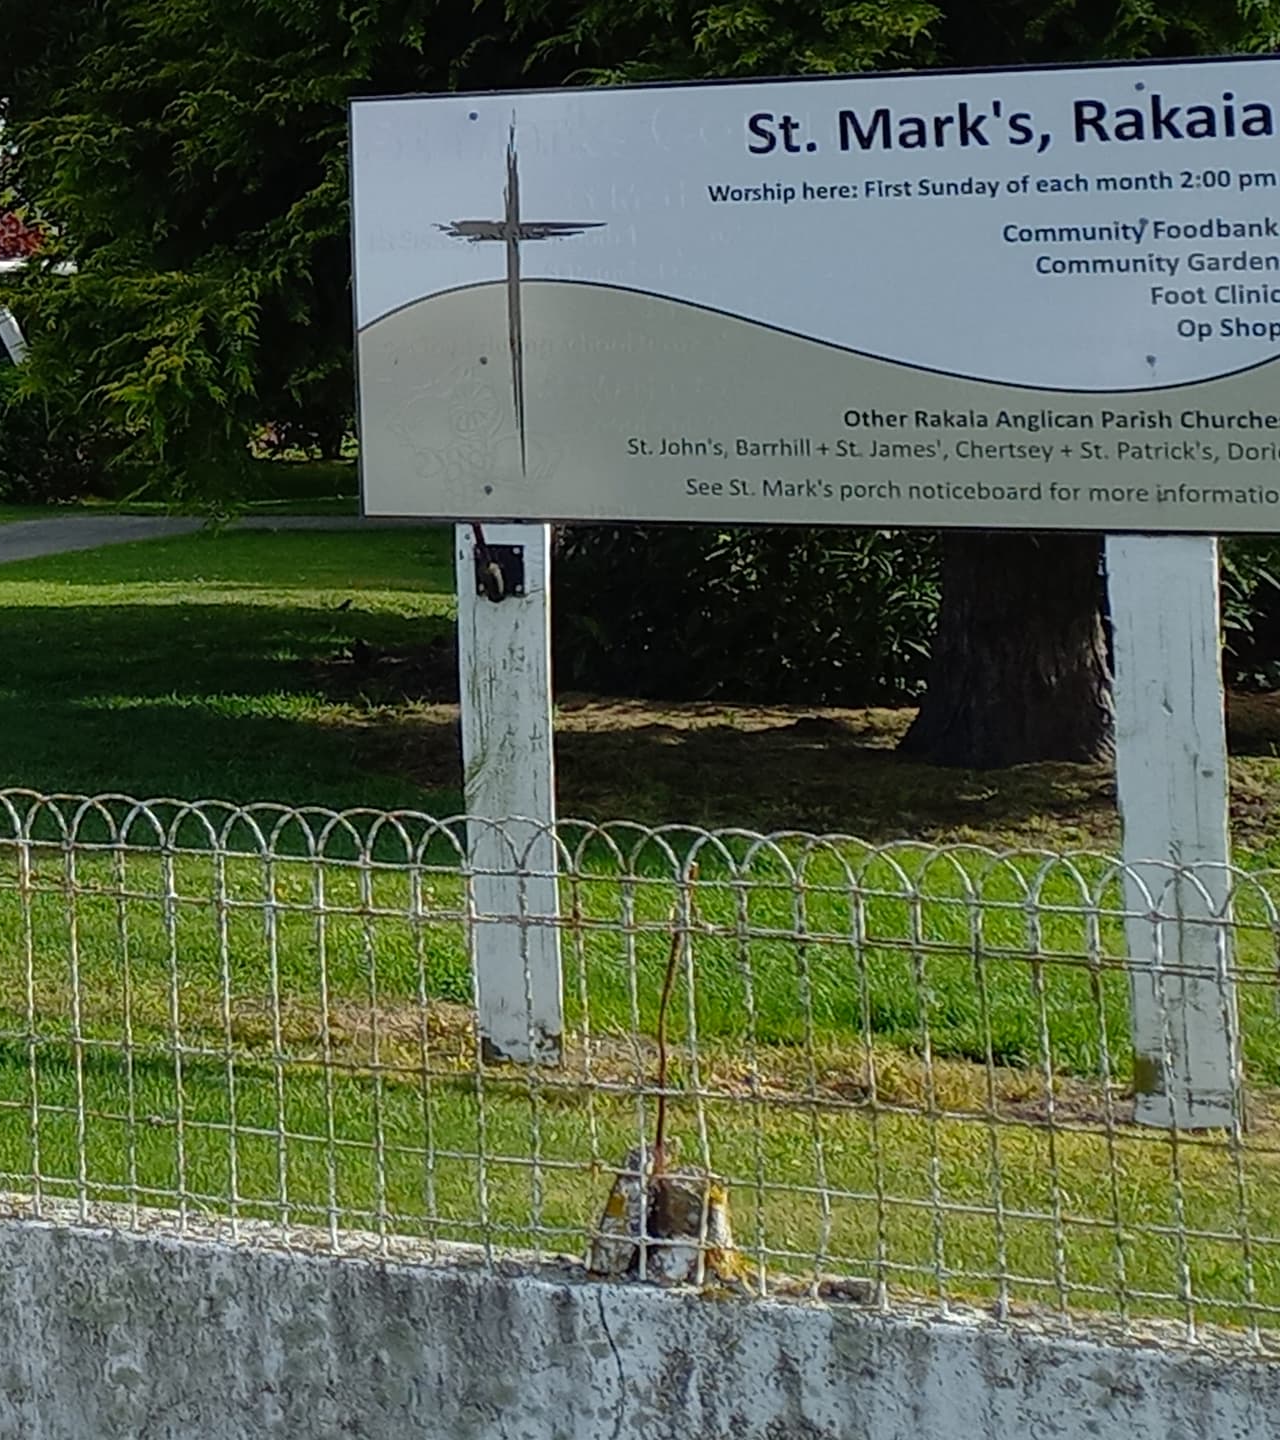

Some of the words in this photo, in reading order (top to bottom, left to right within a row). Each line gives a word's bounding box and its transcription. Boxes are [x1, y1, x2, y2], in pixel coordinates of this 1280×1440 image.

[748, 113, 817, 154] St.
[839, 100, 1051, 154] Mark's,
[1073, 92, 1274, 143] Rakaia
[708, 182, 796, 204] Worship
[802, 181, 858, 201] here:
[865, 179, 912, 198] First
[918, 177, 1000, 199] Sunday
[1006, 175, 1030, 194] of
[1036, 173, 1089, 192] each
[1096, 170, 1173, 191] month
[1180, 170, 1231, 189] 2:00
[1239, 171, 1276, 191] pm
[1003, 220, 1147, 244] Community
[1153, 217, 1279, 240] Foodbank
[1036, 252, 1180, 276] Community
[1187, 251, 1280, 272] Garden
[1151, 286, 1208, 305] Foot
[1215, 284, 1280, 304] Clinic
[1177, 318, 1213, 341] Op
[1220, 317, 1280, 341] Shop
[844, 410, 907, 428] Other
[915, 410, 988, 428] Rakaia
[995, 410, 1093, 432] Anglican
[1101, 411, 1172, 429] Parish
[1180, 411, 1280, 429] Churche
[628, 438, 653, 456] St.
[659, 438, 728, 459] John's,
[736, 438, 811, 457] Barrhill
[836, 439, 861, 458] St.
[869, 440, 949, 460] James',
[955, 441, 1053, 462] Chertsey
[1080, 442, 1108, 460] St.
[1118, 441, 1219, 463] Patrick's,
[1227, 441, 1280, 461] Dori
[686, 478, 723, 496] See
[729, 479, 756, 496] St.
[763, 479, 833, 498] Mark's
[840, 480, 901, 501] porch
[908, 482, 1041, 501] noticeboard
[1049, 482, 1081, 501] for
[1089, 487, 1149, 501] more
[1156, 484, 1280, 504] informatio
